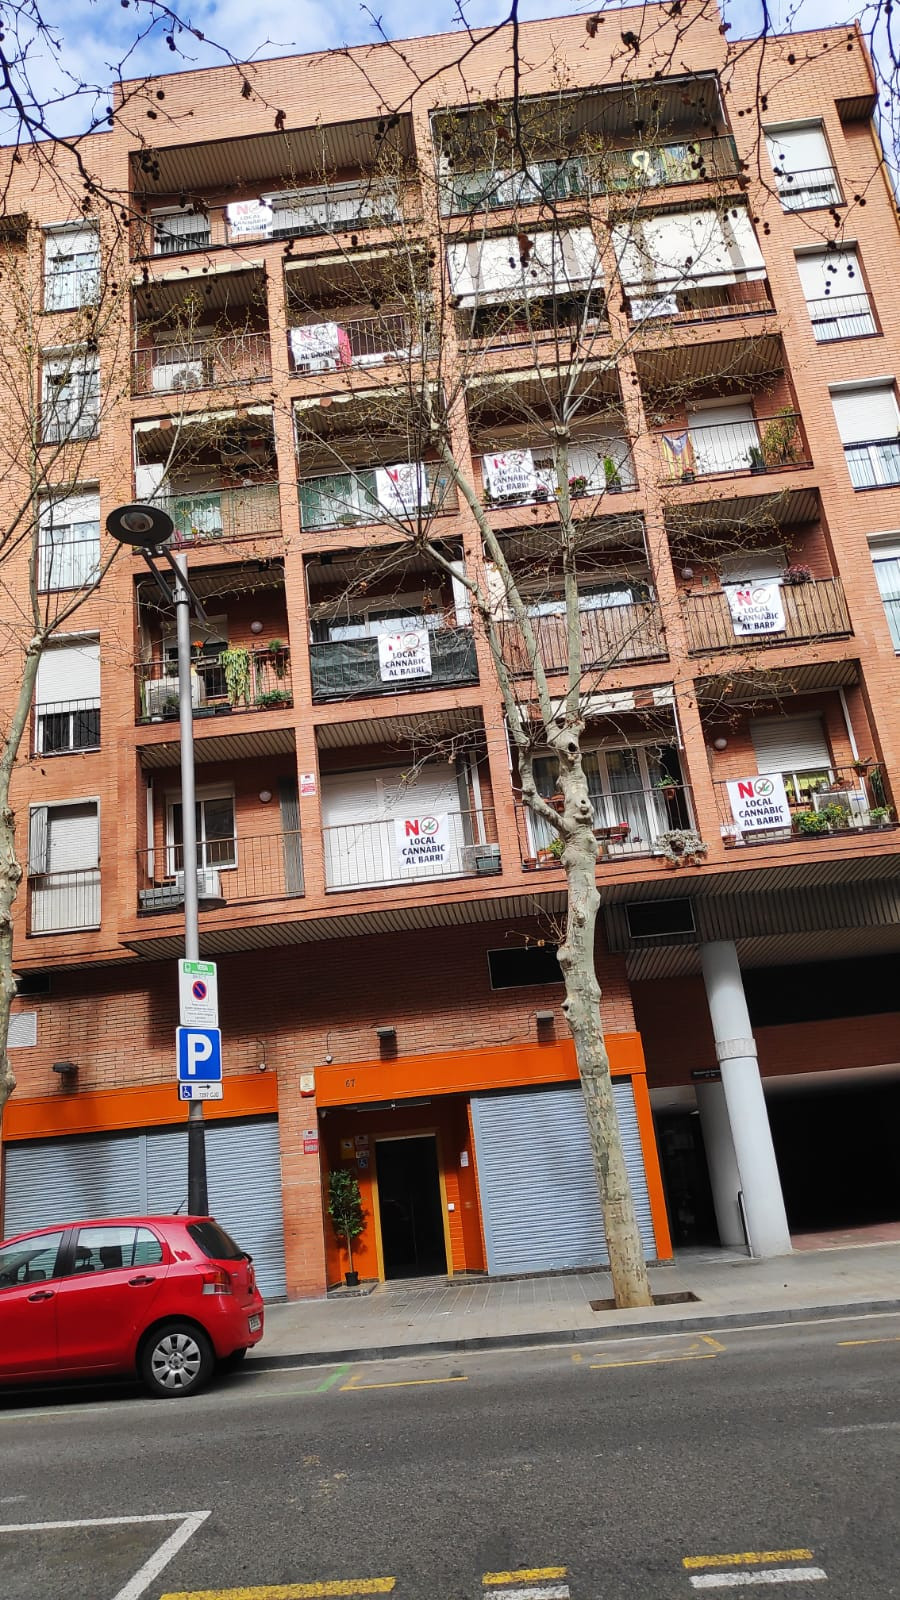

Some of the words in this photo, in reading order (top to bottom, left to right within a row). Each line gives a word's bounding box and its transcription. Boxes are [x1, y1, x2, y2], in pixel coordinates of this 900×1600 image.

[742, 623, 752, 631] AL
[745, 797, 773, 808] LOCAL
[743, 819, 755, 827] AL
[756, 815, 784, 826] BARRI
[410, 836, 436, 846] LOCAL
[405, 856, 416, 865] AL
[418, 853, 444, 864] BARRI
[187, 1033, 213, 1075] P
